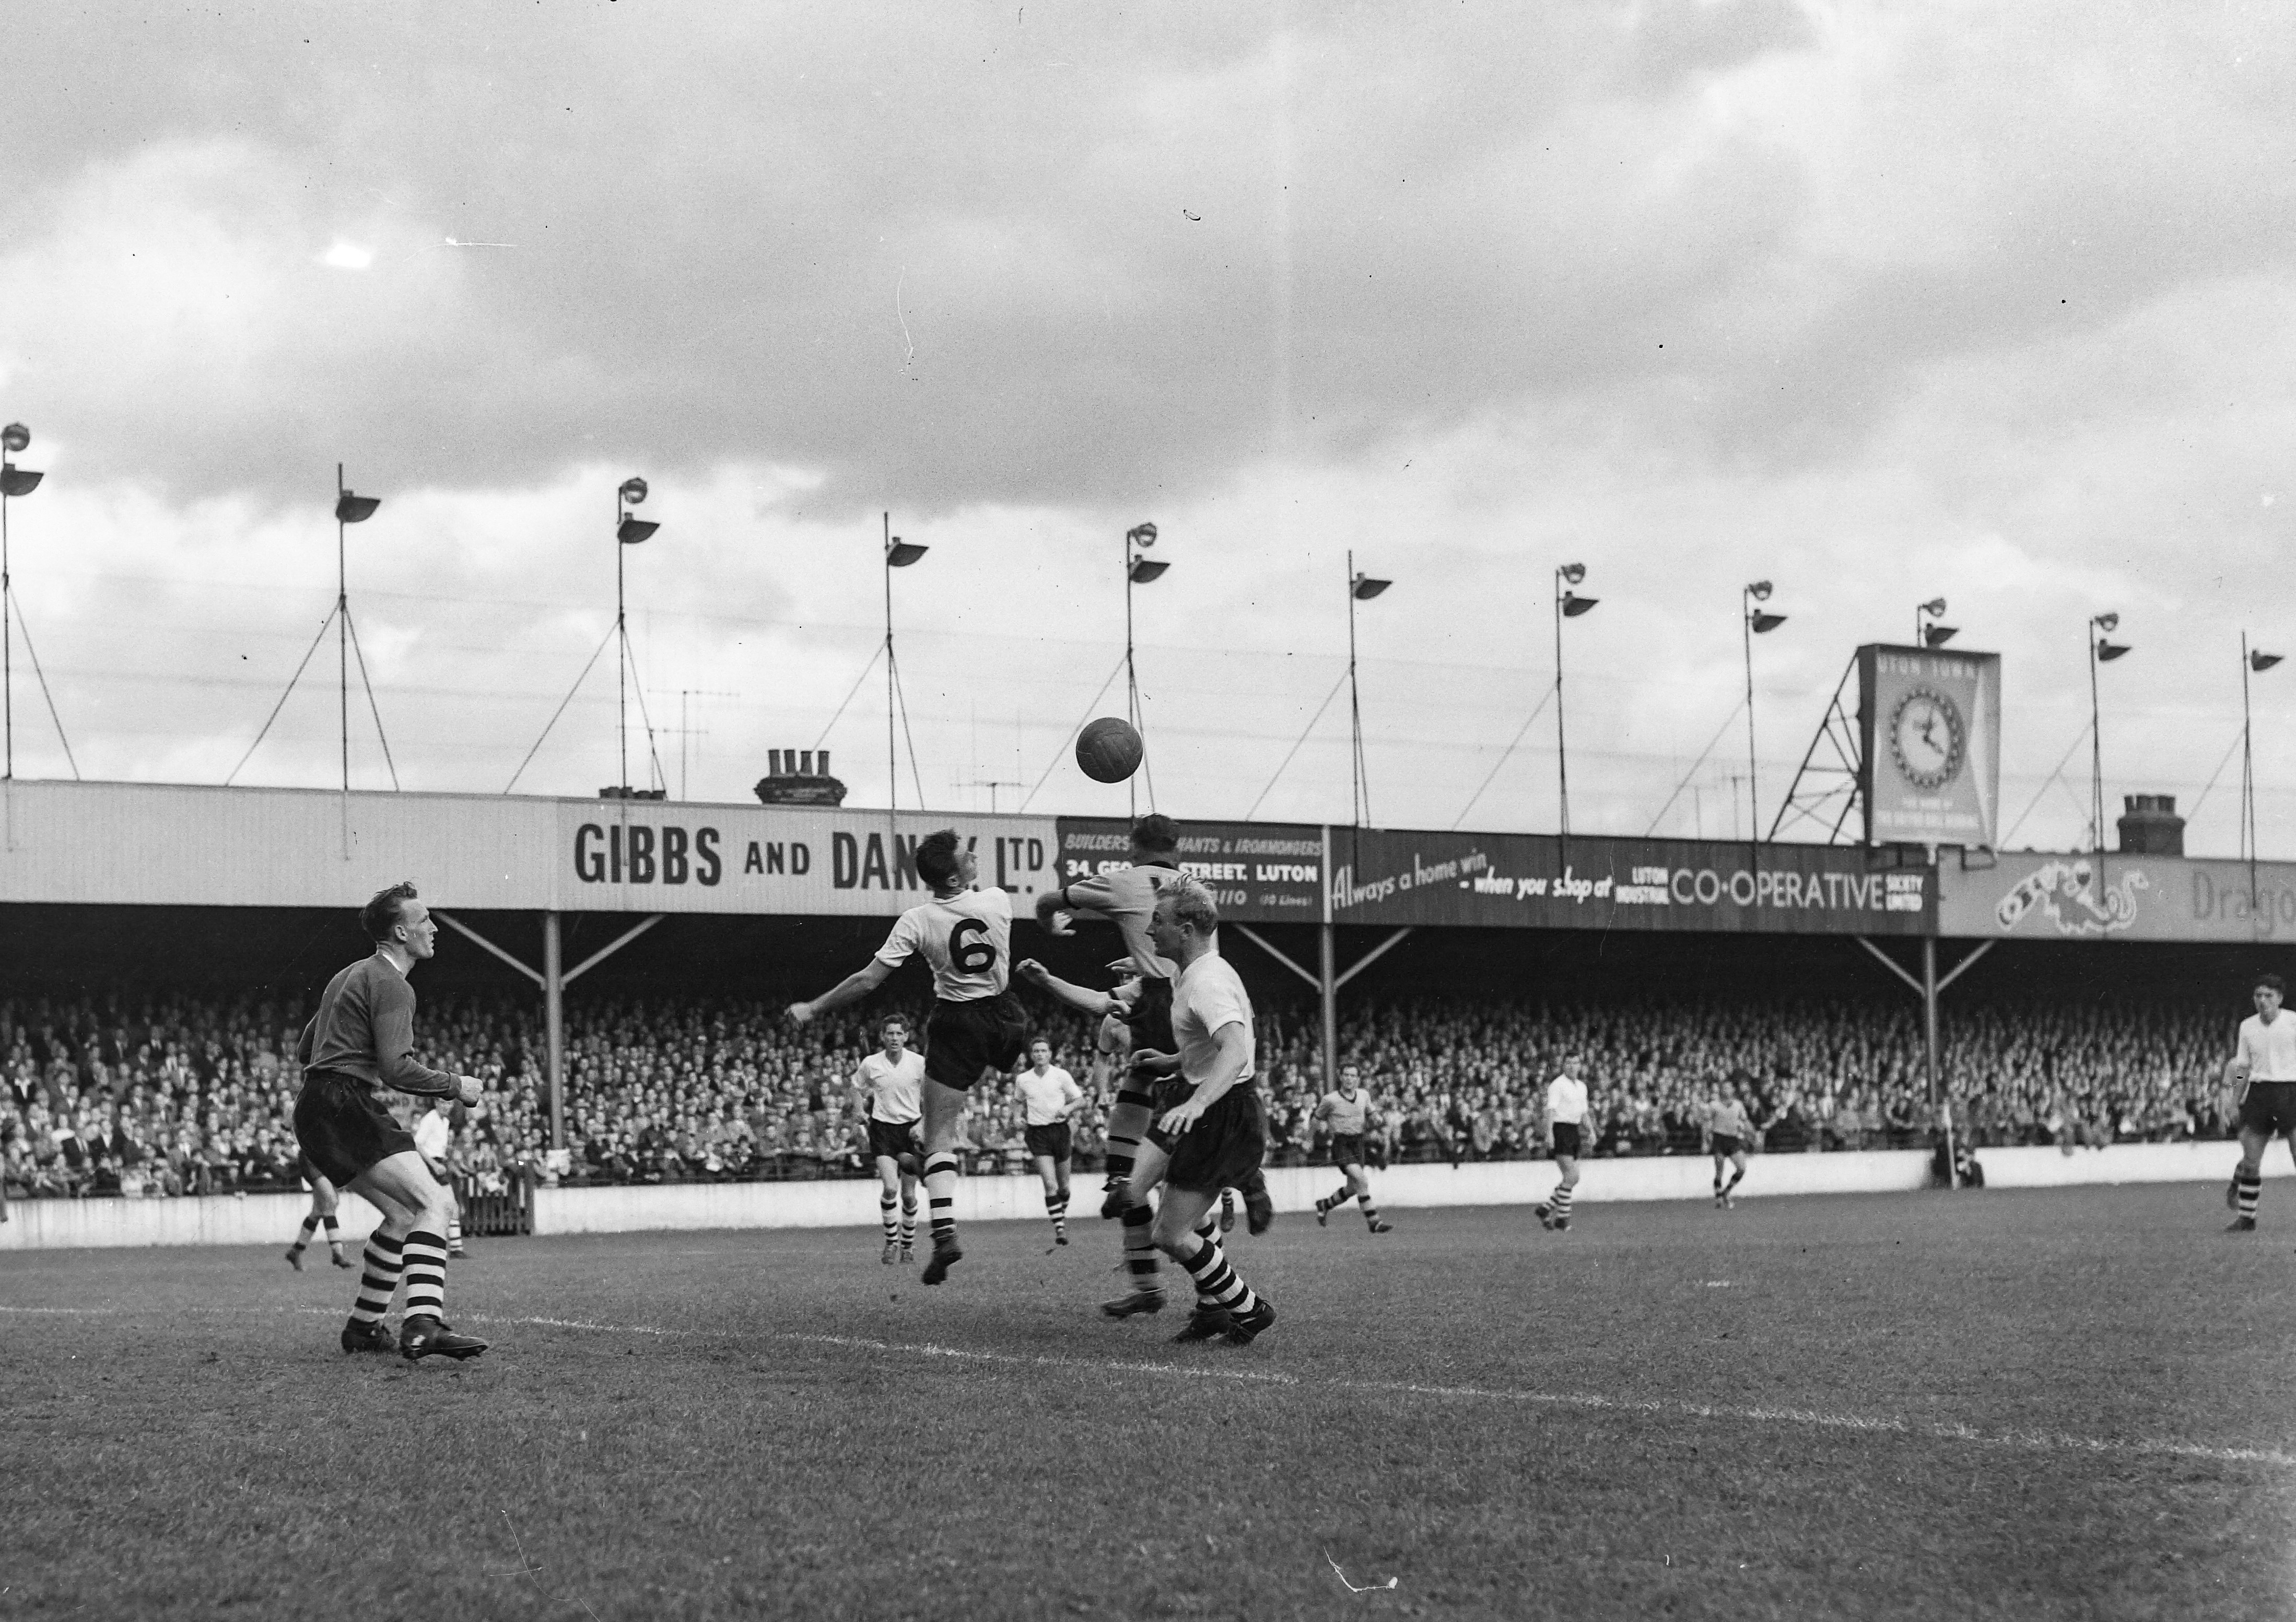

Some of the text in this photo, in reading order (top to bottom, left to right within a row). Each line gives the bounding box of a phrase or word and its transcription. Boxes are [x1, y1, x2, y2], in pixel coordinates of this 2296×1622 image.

[575, 823, 722, 885] GIBBS
[745, 841, 810, 875] AND
[833, 831, 980, 894] DAN.
[1097, 860, 1133, 877] GEO
[1256, 863, 1318, 883] LUTON
[1333, 847, 1487, 911] Always a home win
[1217, 890, 1247, 905] 110
[1474, 865, 1514, 894] when
[1516, 877, 1548, 901] you
[1552, 865, 1592, 904] shop
[1594, 875, 1613, 897] at
[949, 919, 995, 974] 6
